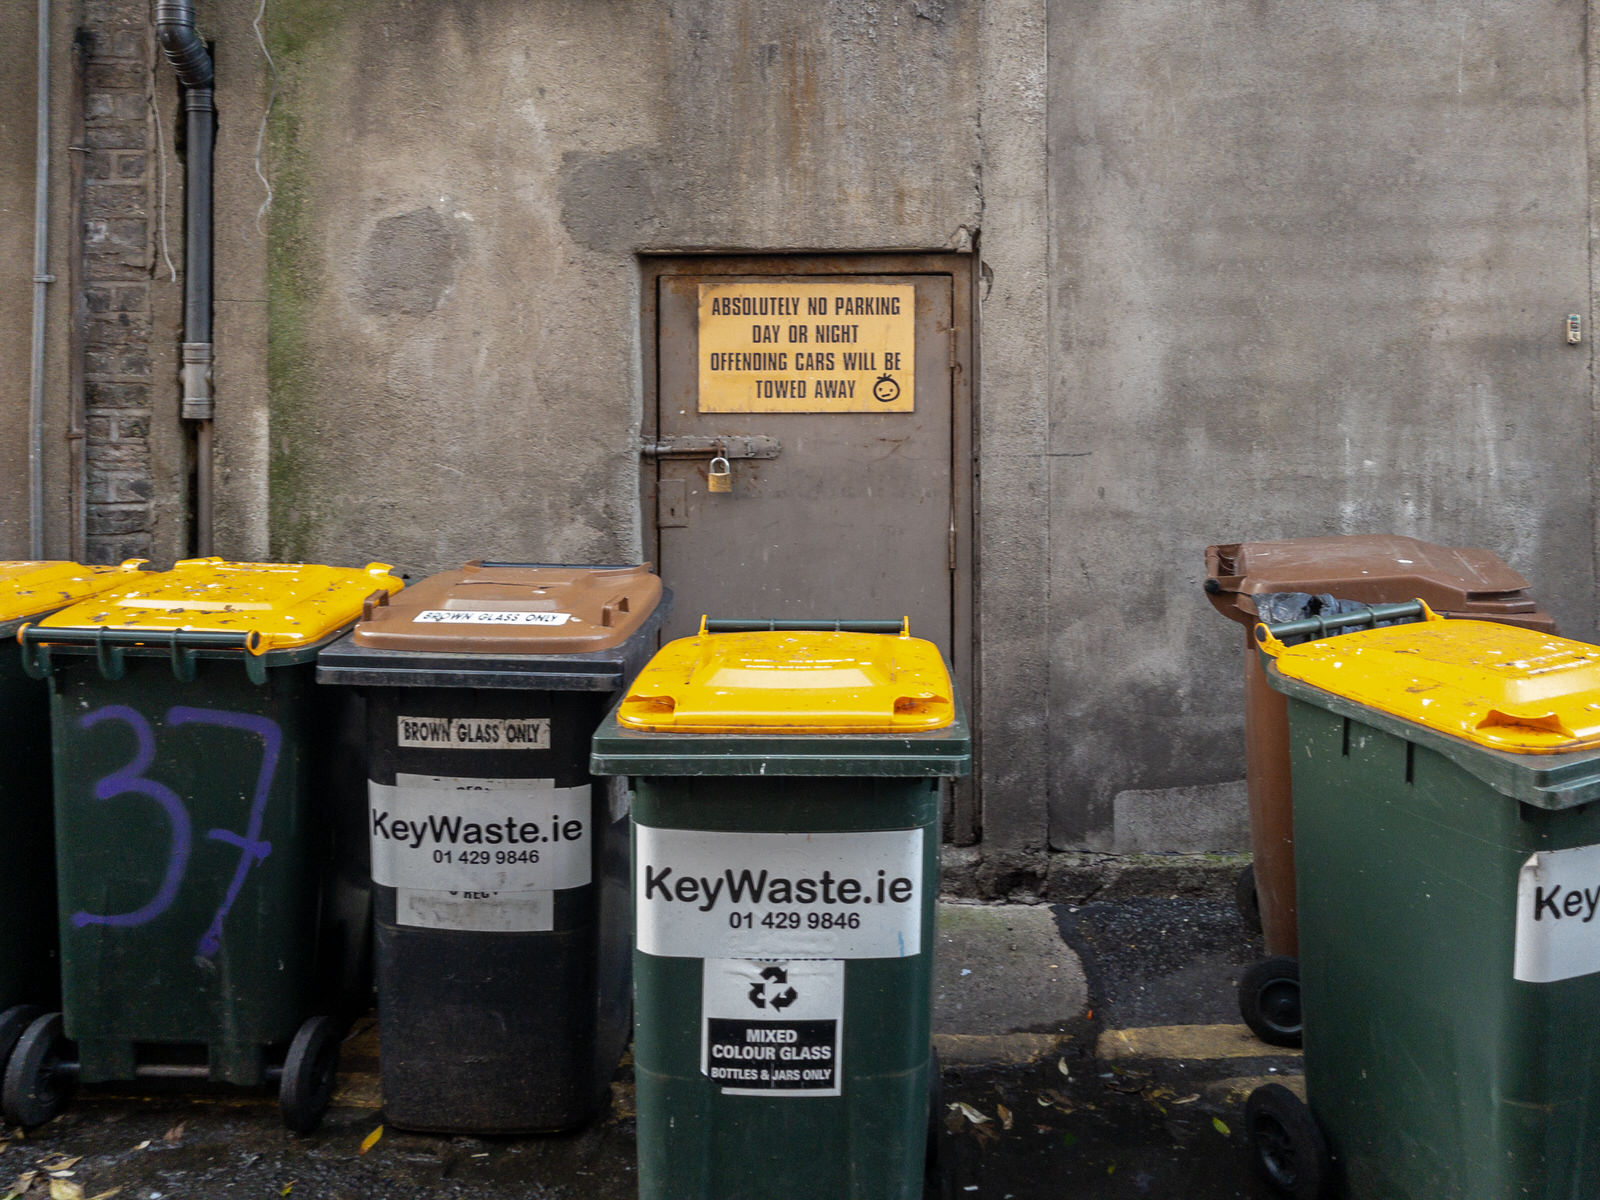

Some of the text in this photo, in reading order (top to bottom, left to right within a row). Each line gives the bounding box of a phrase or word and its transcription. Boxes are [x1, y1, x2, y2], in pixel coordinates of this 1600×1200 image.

[712, 297, 900, 316] ABSOLUTELY NO PARKING
[753, 325, 859, 343] DAY OR NIGHT
[711, 352, 901, 371] OFFENDING CARS WILL BE
[756, 380, 856, 398] TOWED AWAY
[423, 612, 559, 623] BROWN GLASS ONLY
[404, 721, 540, 744] BROWN GLASS ONLY
[71, 704, 282, 958] 37
[372, 808, 583, 848] KeyWaste.ie
[433, 850, 540, 864] 01 429 9846
[645, 865, 913, 912] KeyWaste.ie
[729, 912, 860, 929] 01 429 9846
[746, 1029, 798, 1043] MIXED
[712, 1044, 831, 1060] COLOUR GLASS
[711, 1067, 832, 1081] BOTTLES & JARS ONLY
